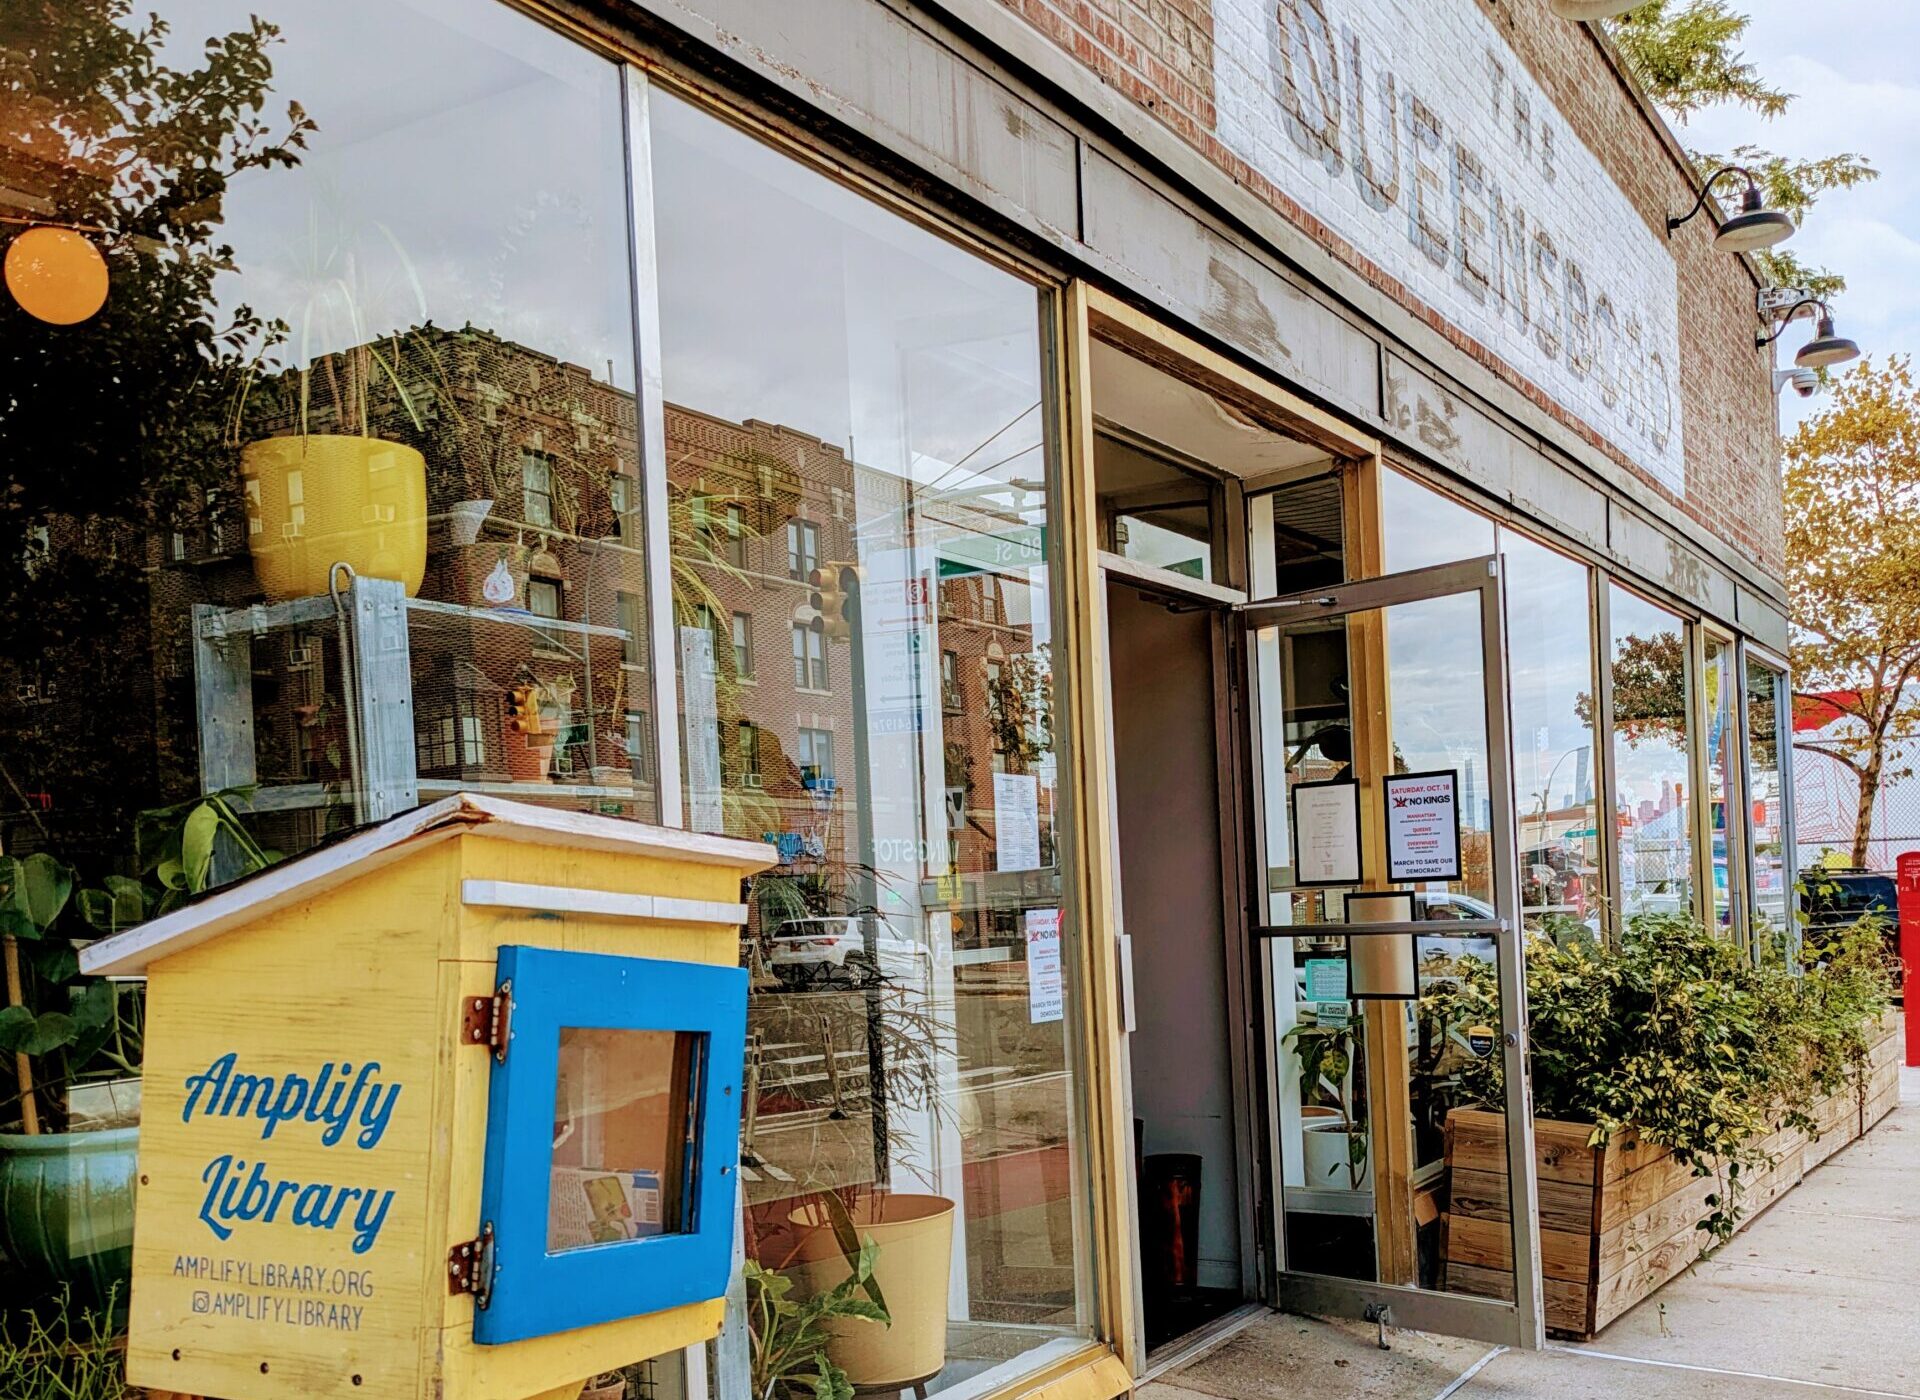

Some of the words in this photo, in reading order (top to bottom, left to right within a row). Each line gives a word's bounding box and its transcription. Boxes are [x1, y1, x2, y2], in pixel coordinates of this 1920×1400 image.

[1391, 786, 1425, 795] SATURDAY,
[1426, 784, 1442, 792] OCT.
[1410, 797, 1422, 806] NO
[1424, 795, 1450, 804] KINGS
[1040, 930, 1049, 939] NO
[1040, 1009, 1061, 1018] DEMOCRAC
[182, 1053, 402, 1149] Amplify
[198, 1155, 396, 1254] Library
[173, 1255, 374, 1298] AMPLIFYLIBRARY.ORG
